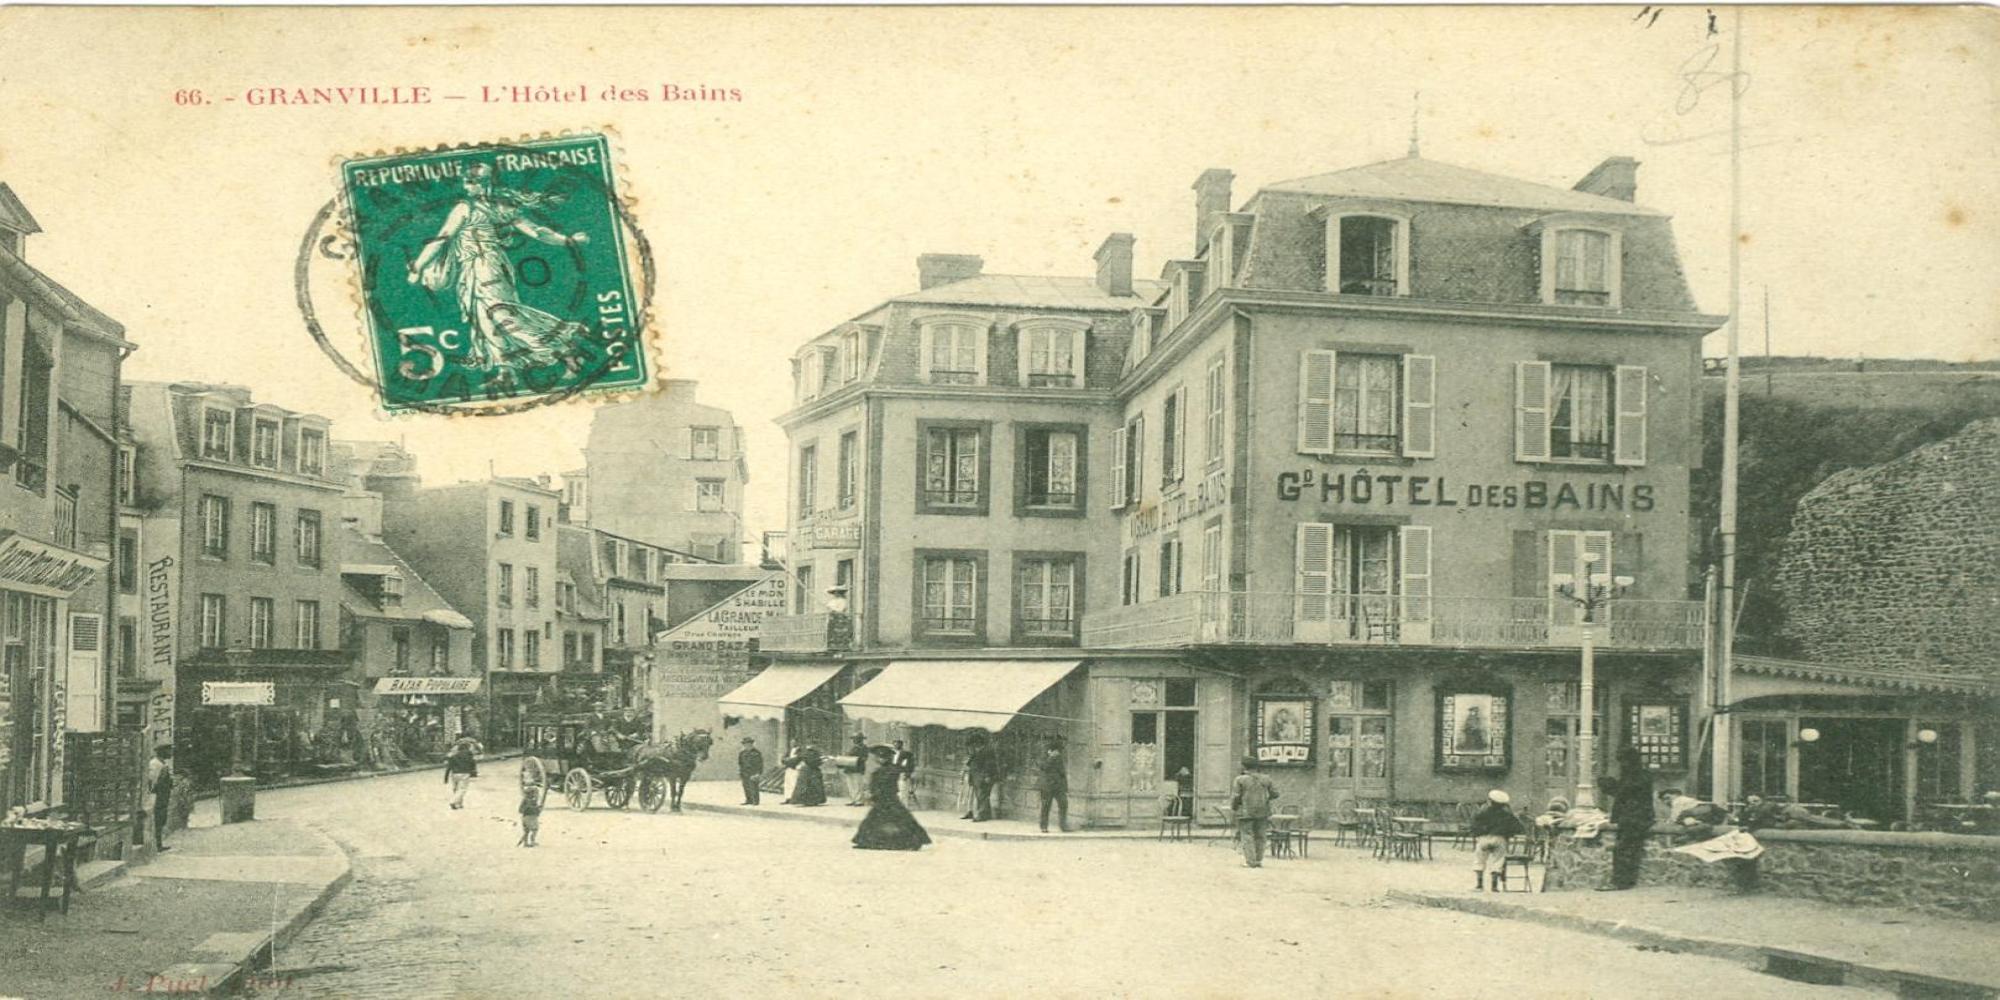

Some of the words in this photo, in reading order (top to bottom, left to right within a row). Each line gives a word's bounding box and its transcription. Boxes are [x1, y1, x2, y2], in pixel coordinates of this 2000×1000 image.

[495, 145, 599, 173] FRANÇAISE
[597, 290, 631, 372] POSTES
[1320, 468, 1458, 507] HÔTEL
[1467, 484, 1518, 509] DES
[1523, 480, 1656, 513] BAINS
[149, 555, 174, 666] RESTAURANT
[390, 679, 422, 692] BAZAR
